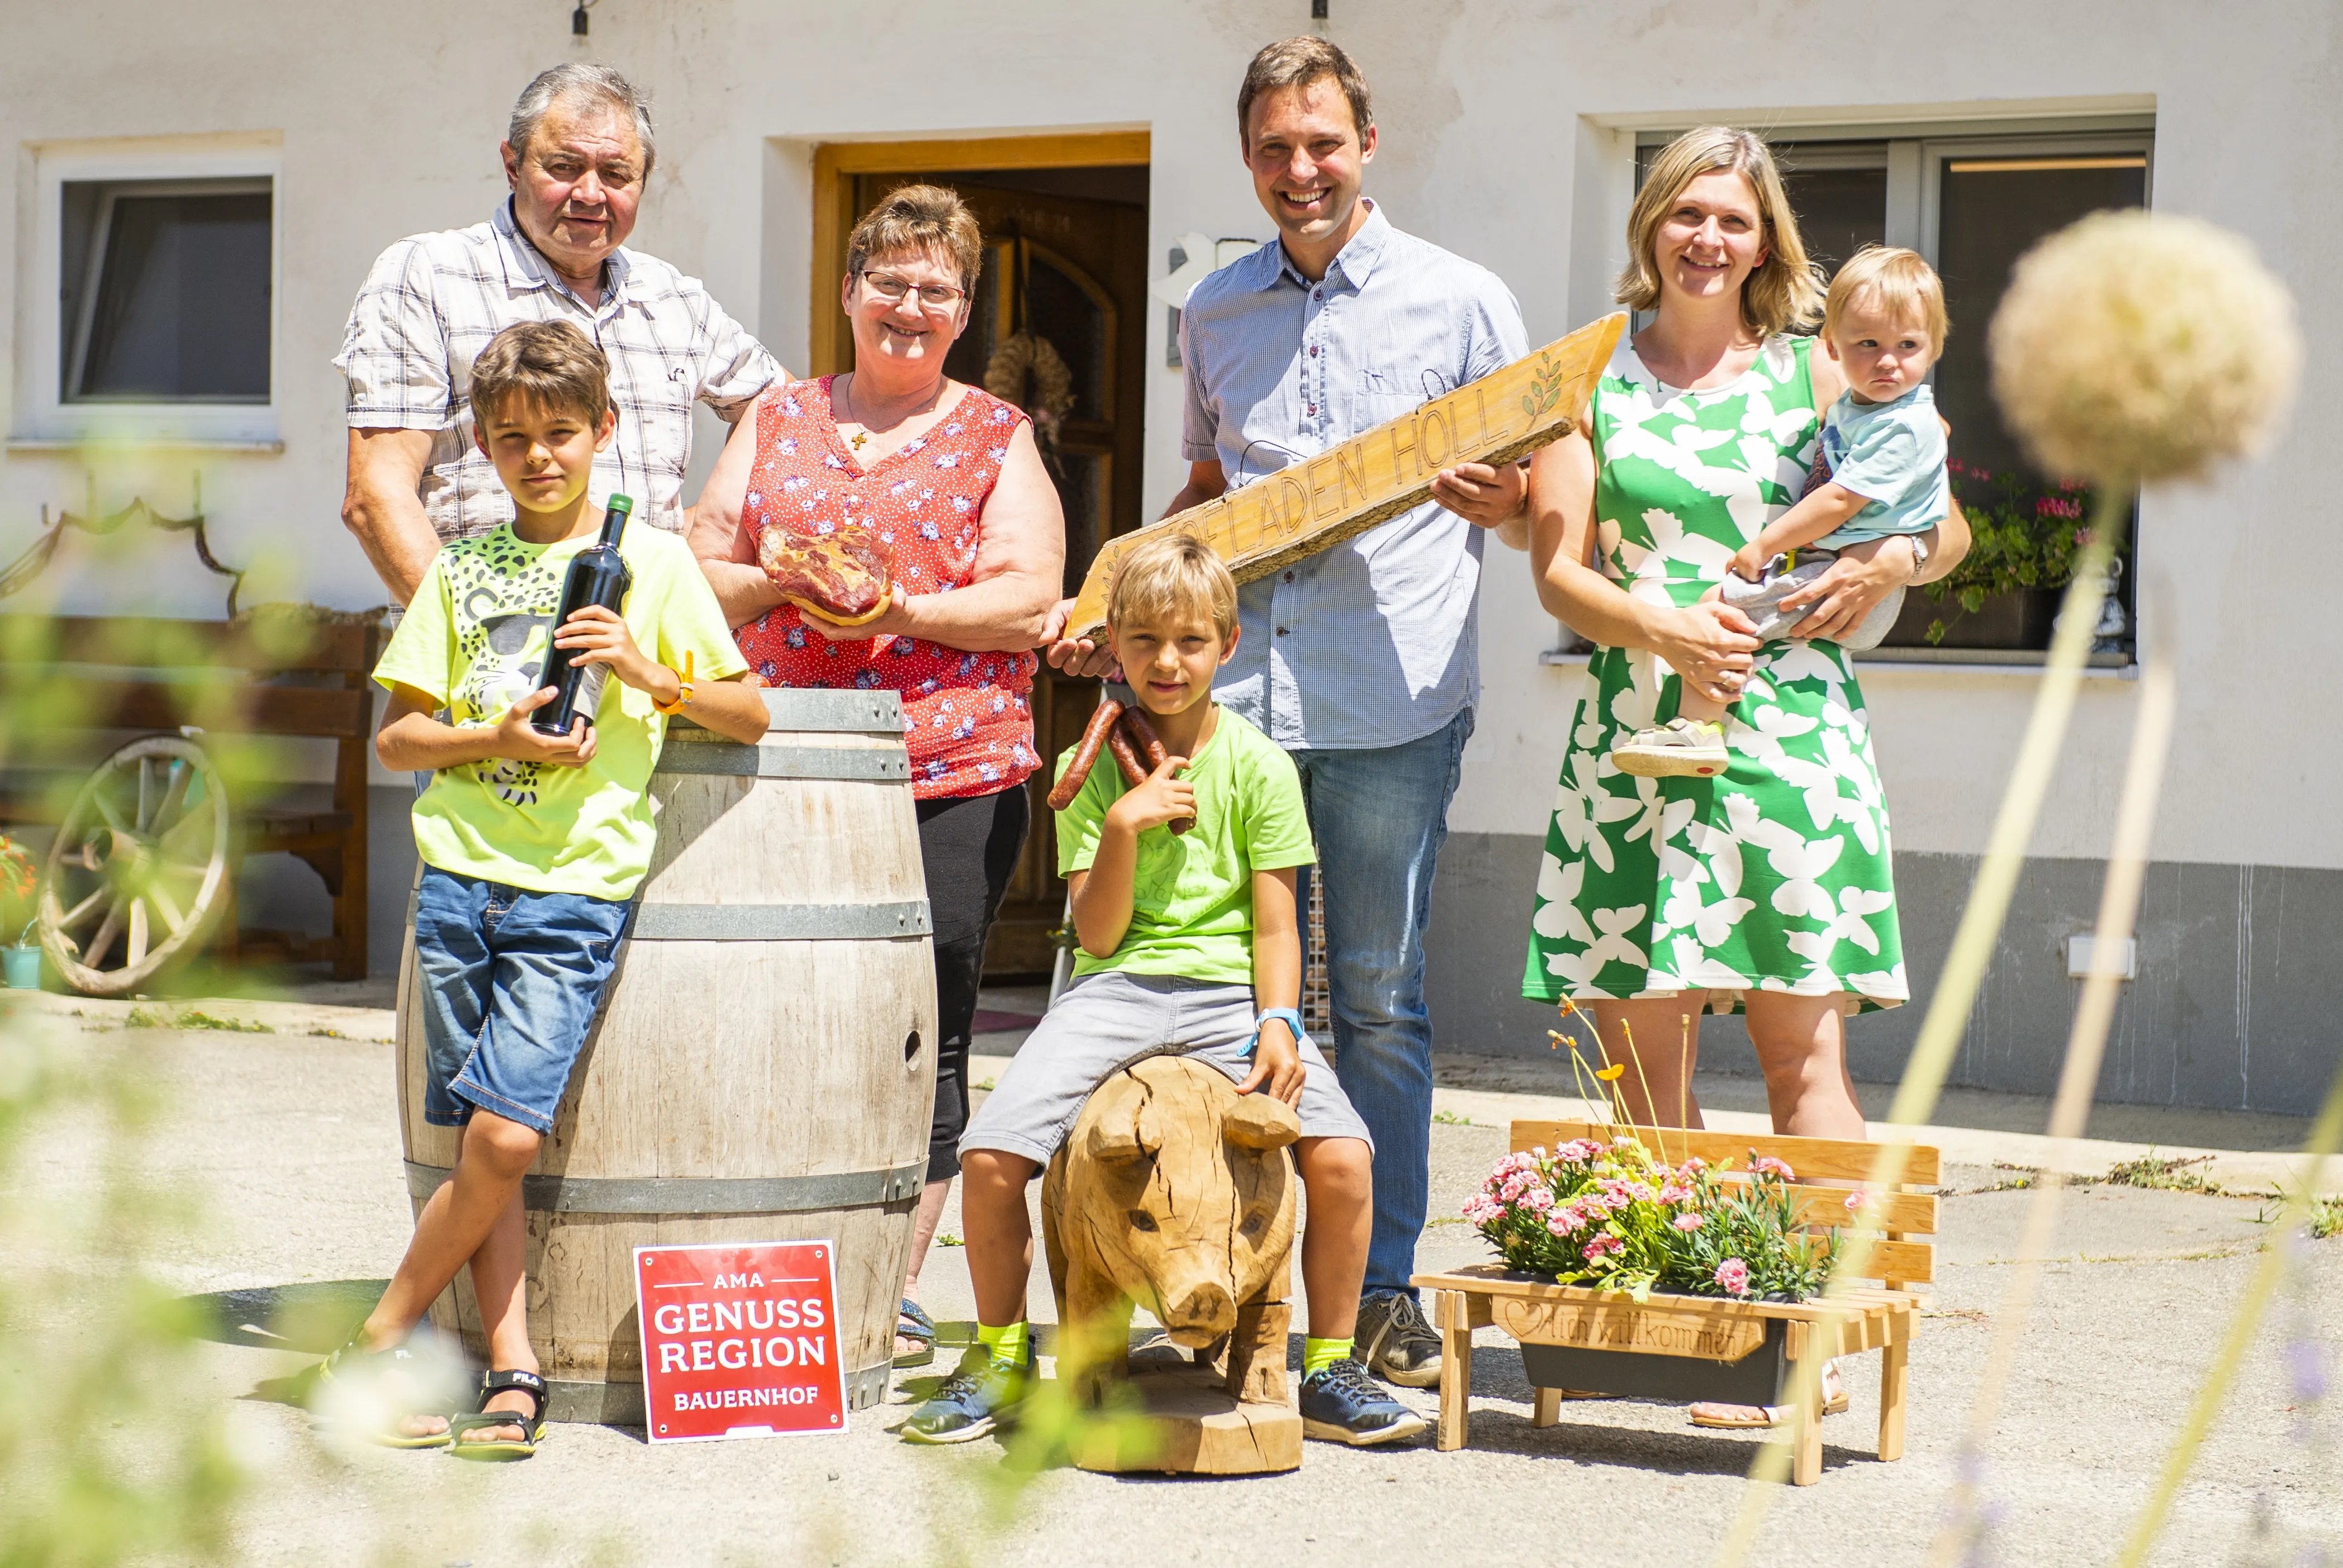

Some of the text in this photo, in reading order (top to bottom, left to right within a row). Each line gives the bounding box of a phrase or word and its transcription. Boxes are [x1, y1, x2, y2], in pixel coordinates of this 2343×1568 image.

[1168, 388, 1509, 558] FLADEN HOLL
[713, 1272, 765, 1289] AMA
[653, 1298, 825, 1334] GENUSS
[1597, 1311, 1736, 1356] willkommen
[395, 1350, 413, 1360] FIL
[658, 1336, 826, 1374] REGION
[512, 1372, 539, 1386] FILA
[674, 1386, 819, 1412] BAUERNHOF
